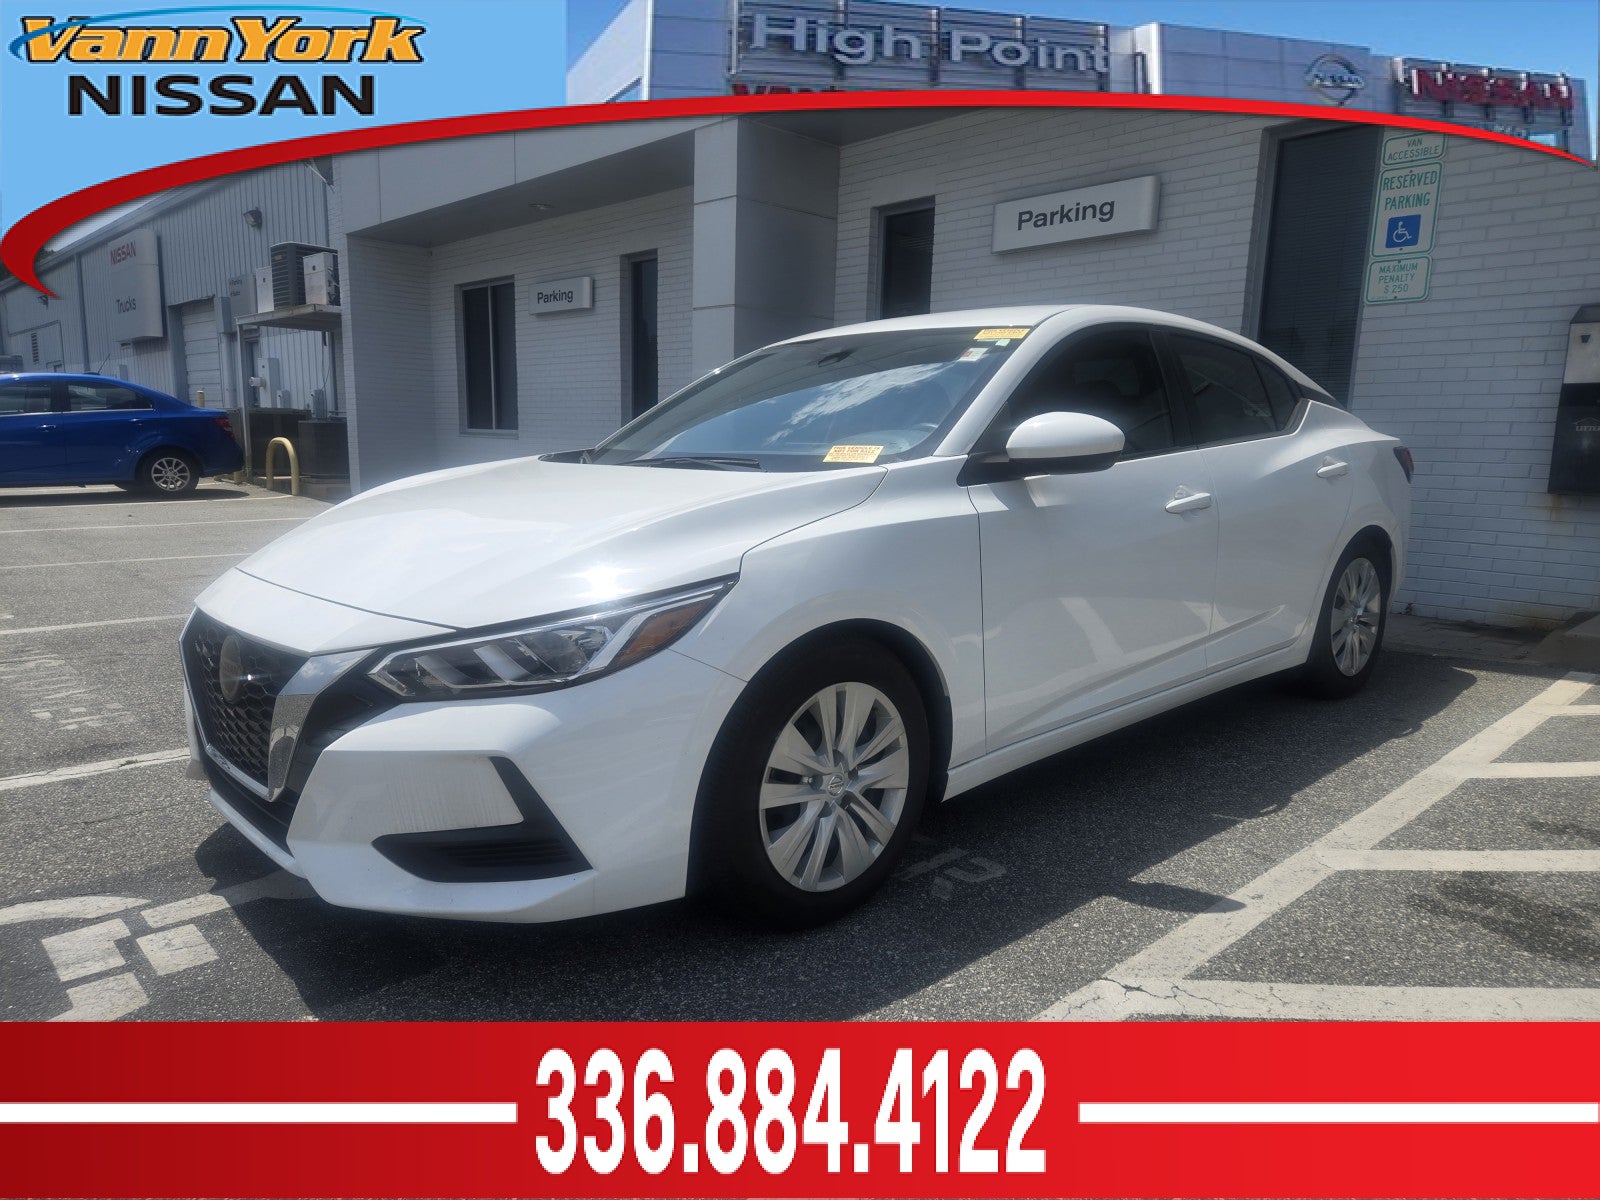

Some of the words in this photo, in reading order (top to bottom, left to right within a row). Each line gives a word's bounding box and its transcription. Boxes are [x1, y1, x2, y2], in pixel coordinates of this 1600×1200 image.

[750, 13, 922, 65] High
[951, 29, 1110, 73] Point
[1407, 138, 1423, 147] VAN
[1387, 146, 1439, 161] ACCESSIBLE
[1383, 171, 1438, 190] RESERVED
[1384, 192, 1431, 211] PARKING
[1017, 199, 1115, 231] Parking
[111, 242, 136, 264] NISSAN
[1379, 263, 1418, 274] MAXIMUM
[1379, 273, 1415, 284] PENALTY
[1392, 284, 1409, 293] 250
[537, 289, 573, 304] Parking
[117, 298, 137, 314] Trucks
